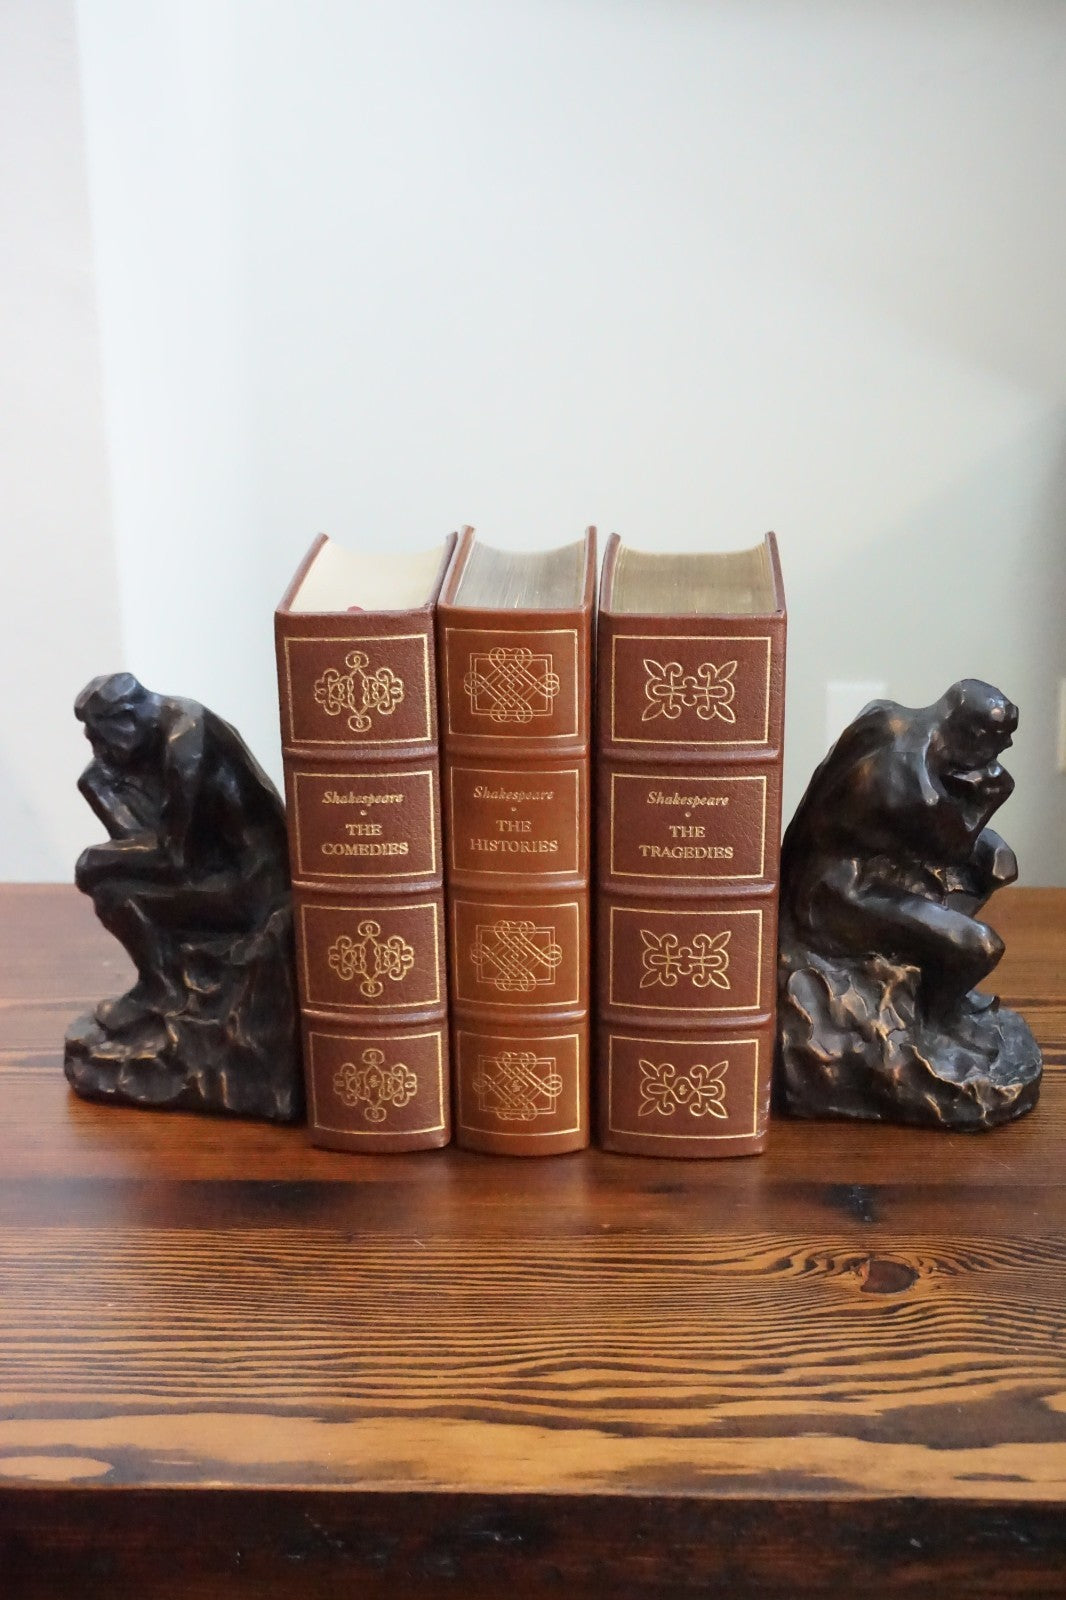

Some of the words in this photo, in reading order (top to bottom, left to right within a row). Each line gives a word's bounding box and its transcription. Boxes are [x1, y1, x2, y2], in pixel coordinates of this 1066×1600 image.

[322, 791, 404, 806] Shakespeare
[473, 785, 554, 803] Shakespeare
[646, 791, 730, 808] Shakespeare
[345, 823, 382, 836] THE
[495, 820, 532, 832] THE
[668, 825, 706, 838] THE
[321, 842, 409, 856] COMEDIES
[470, 839, 558, 853] HISTORIES
[638, 845, 734, 859] TRAGEDIES
